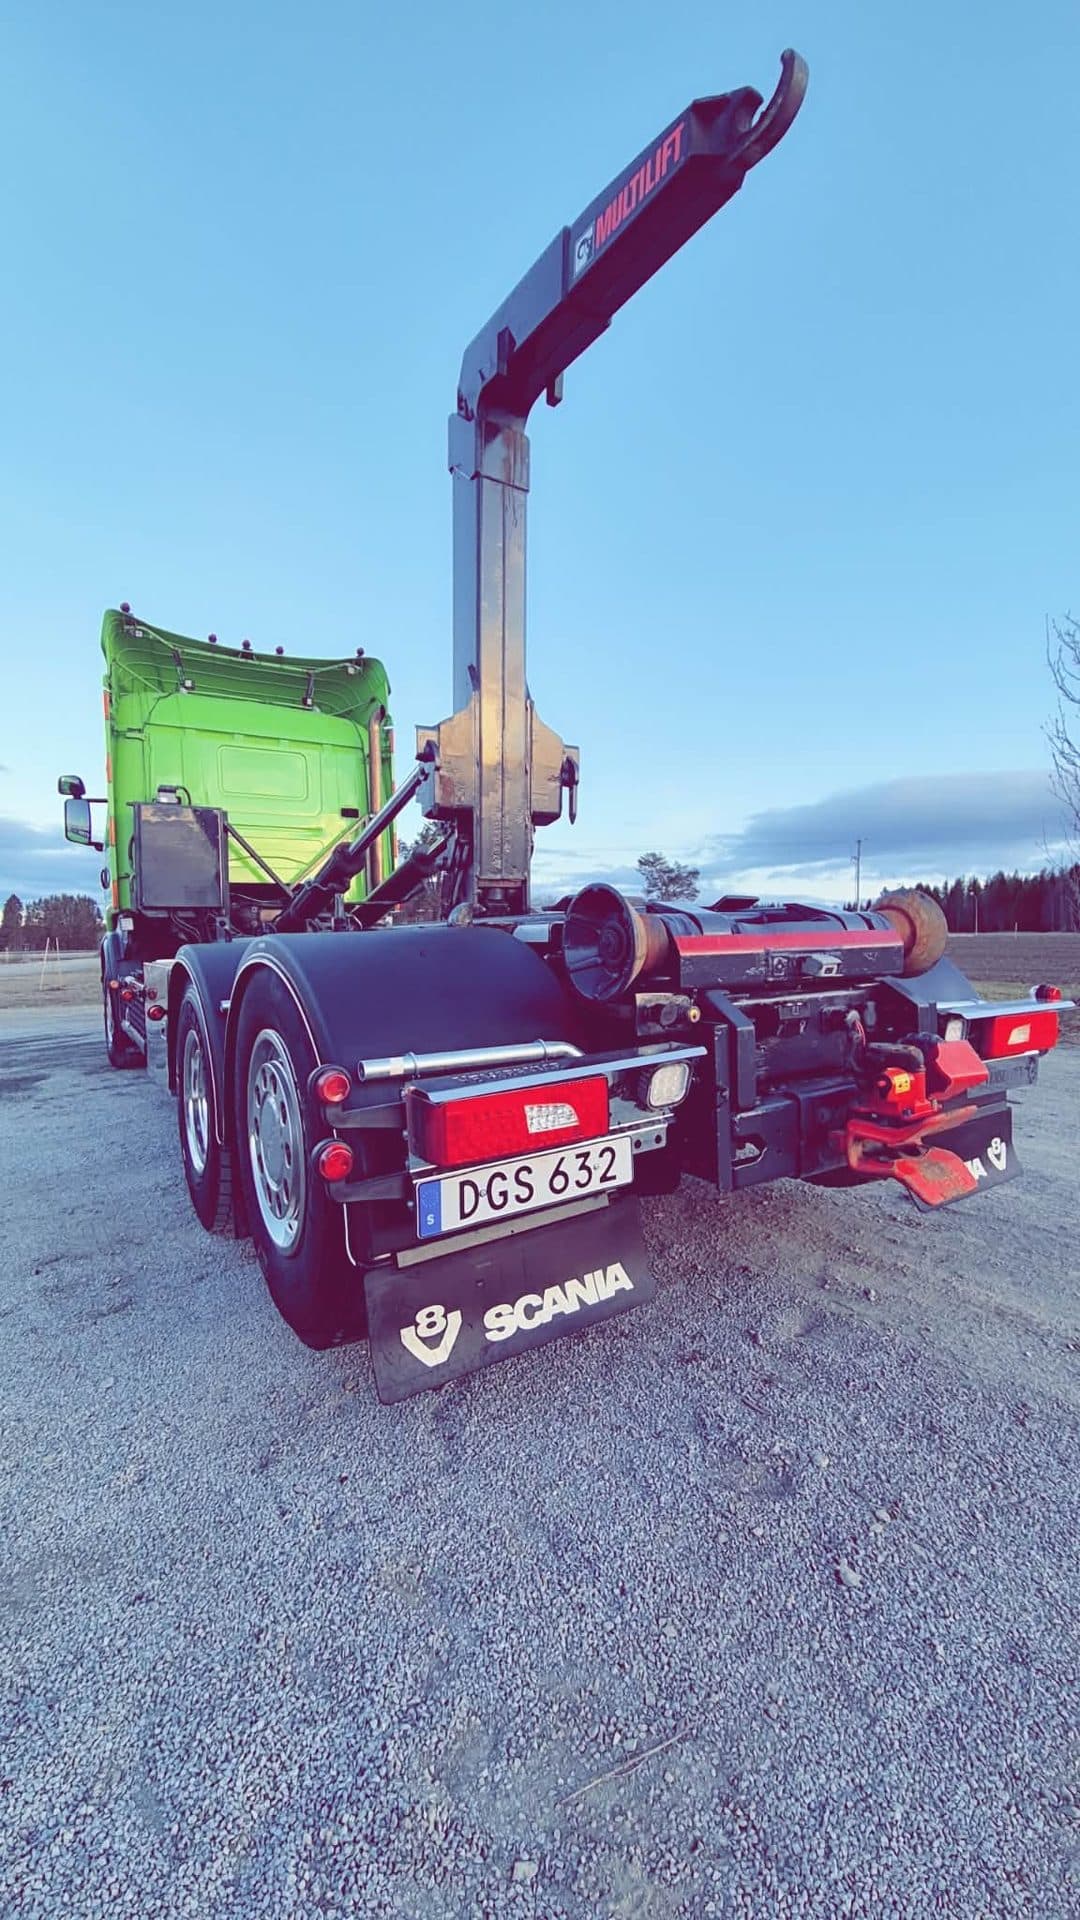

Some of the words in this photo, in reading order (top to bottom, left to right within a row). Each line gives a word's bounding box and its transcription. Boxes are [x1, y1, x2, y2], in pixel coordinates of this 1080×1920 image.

[595, 122, 685, 248] MULTILIFT
[426, 1214, 435, 1225] S
[459, 1165, 534, 1220] DGS
[549, 1146, 617, 1194] 632
[483, 1262, 634, 1342] SCANIA
